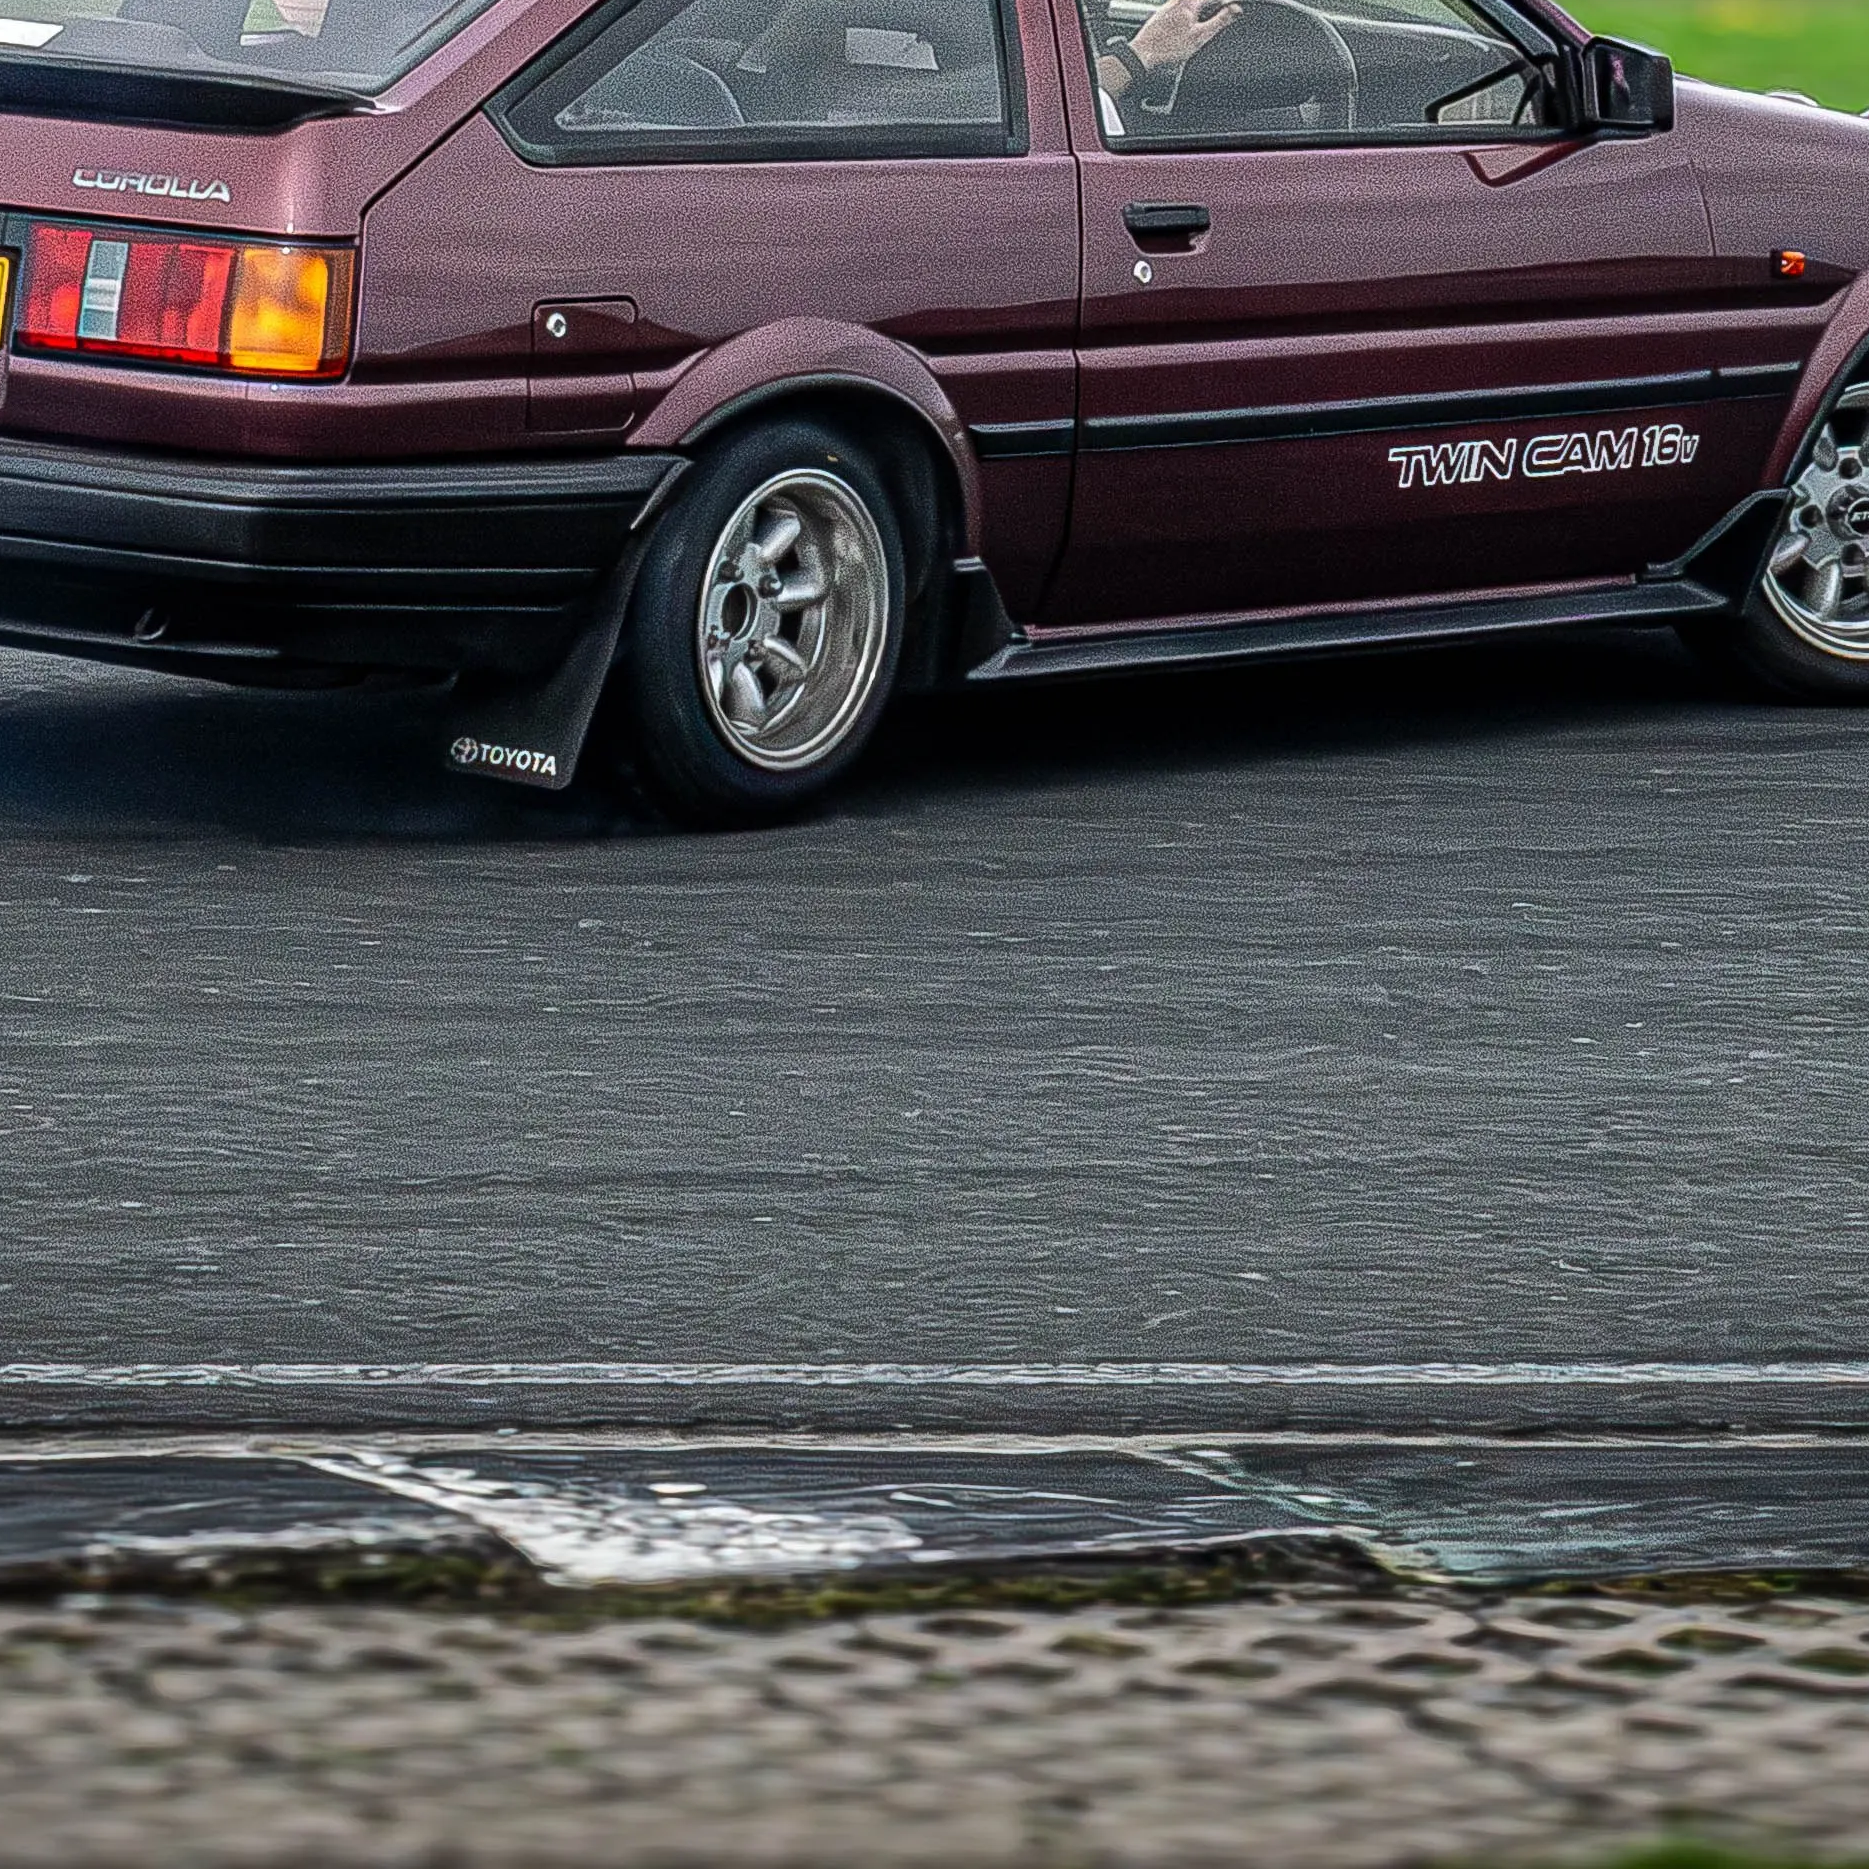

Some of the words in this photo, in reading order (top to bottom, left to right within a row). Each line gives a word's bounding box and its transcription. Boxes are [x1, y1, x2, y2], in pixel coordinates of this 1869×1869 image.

[73, 168, 230, 202] COROLLA
[1388, 438, 1517, 489] TWIN
[1522, 428, 1638, 478] CAM
[480, 743, 557, 776] TOYOTA
